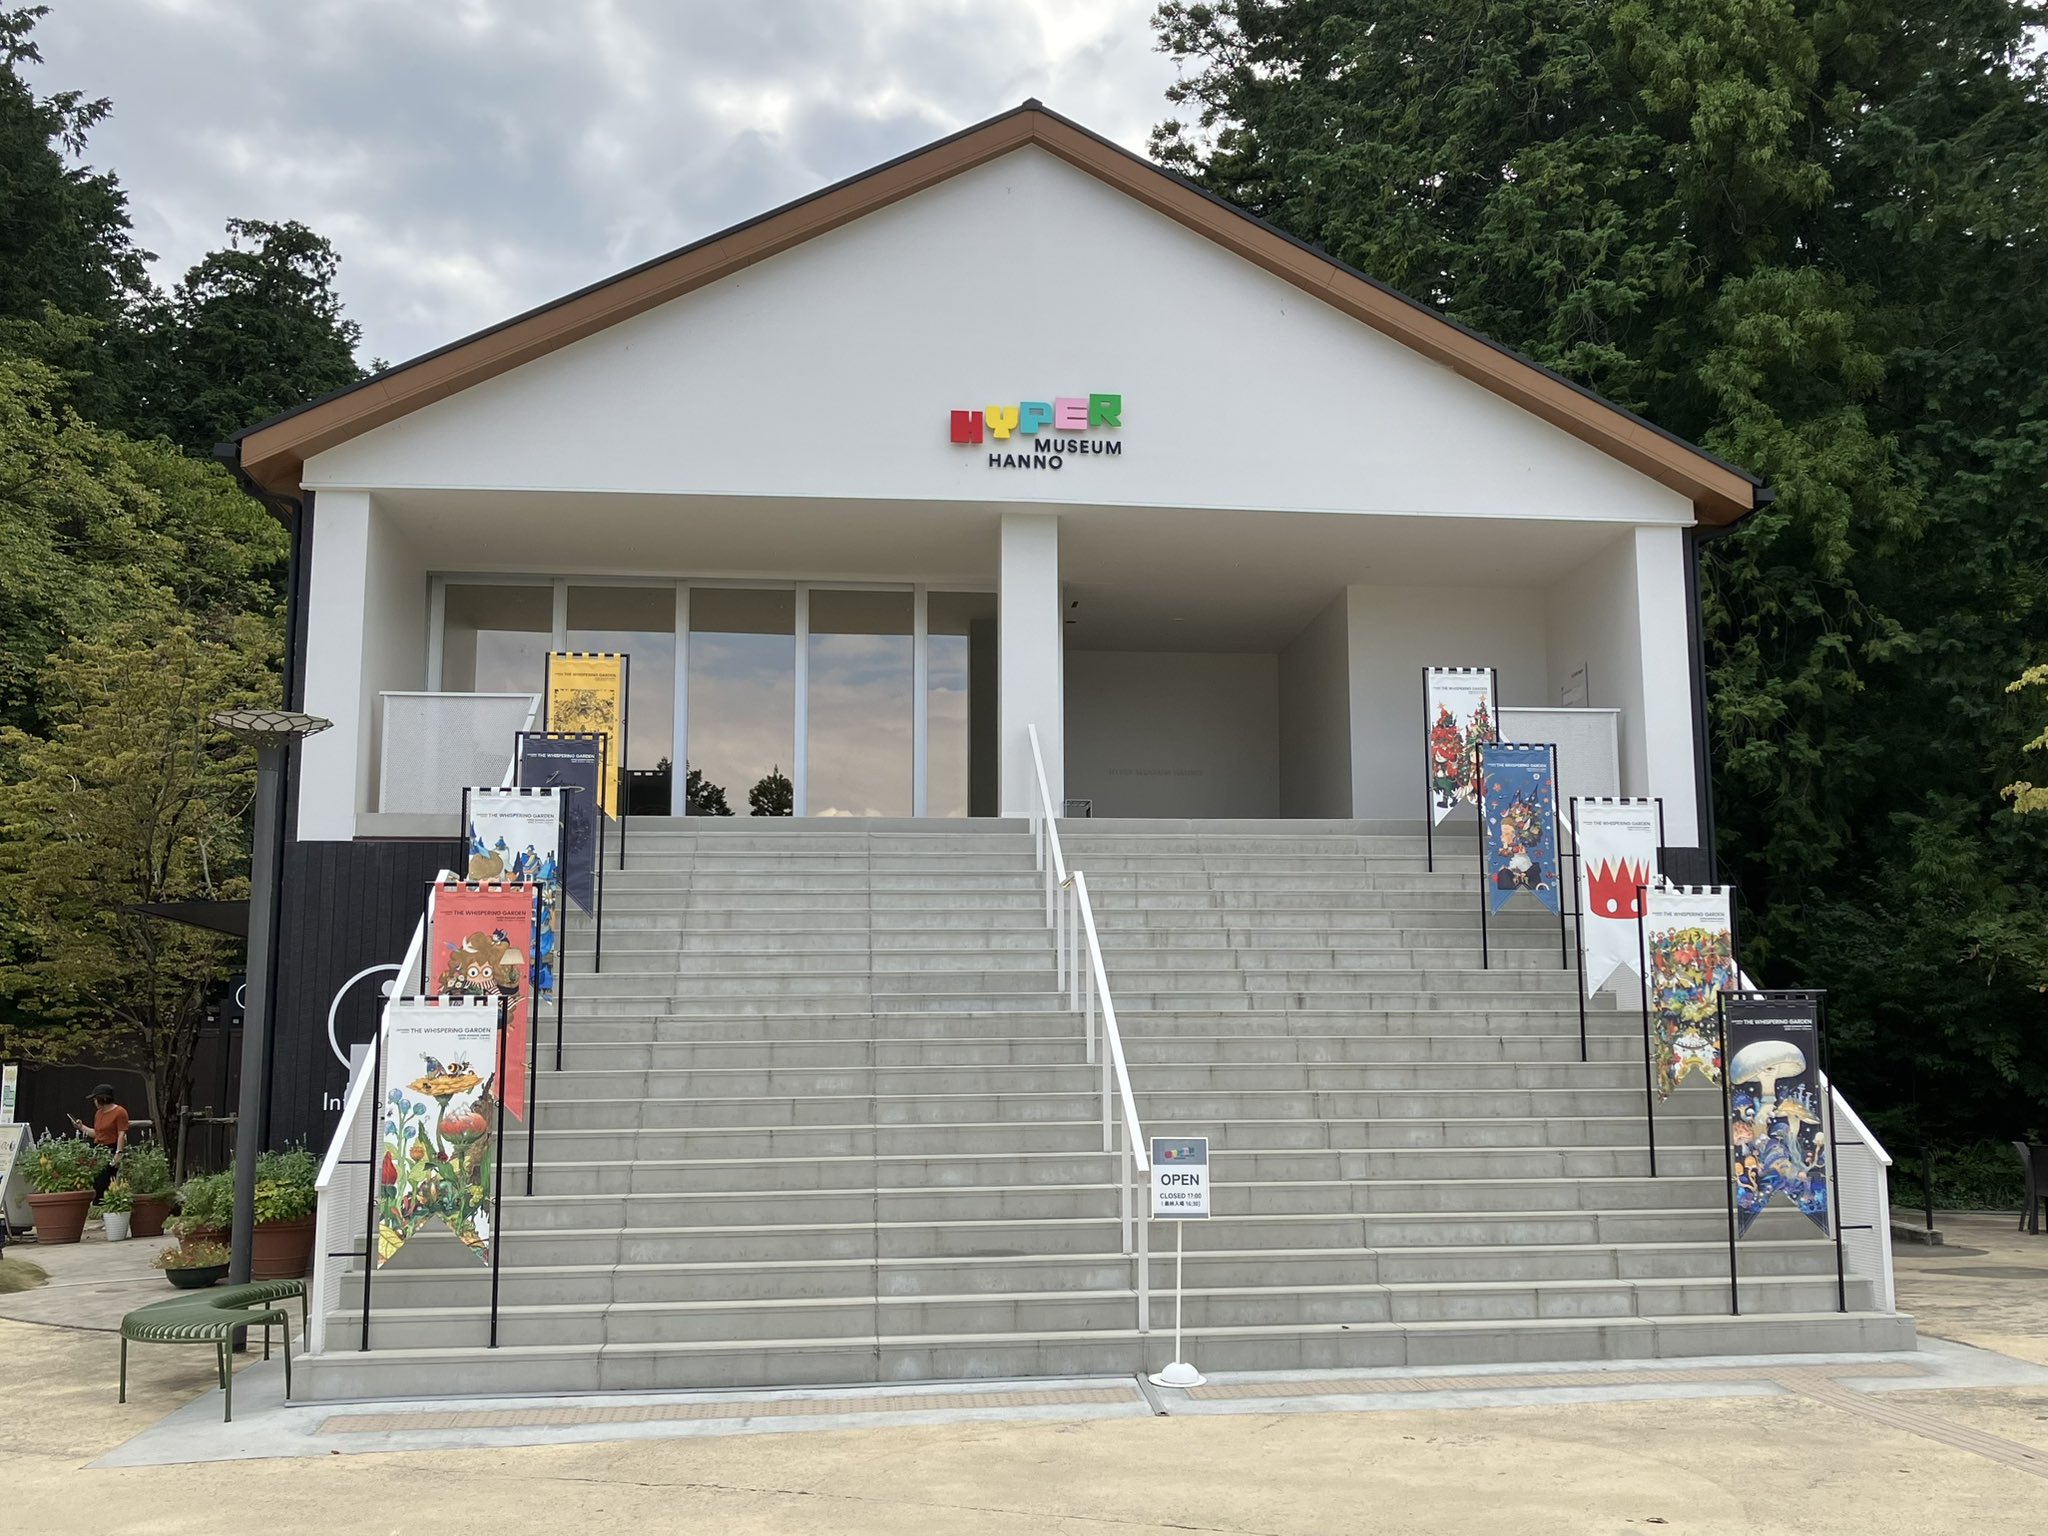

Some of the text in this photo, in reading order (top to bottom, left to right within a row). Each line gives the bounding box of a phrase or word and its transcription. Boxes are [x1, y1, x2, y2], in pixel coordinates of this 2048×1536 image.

[950, 393, 1122, 444] HYPER
[1034, 438, 1122, 455] MUSEUM
[988, 453, 1063, 470] HANNO
[1161, 1174, 1200, 1186] OPEN
